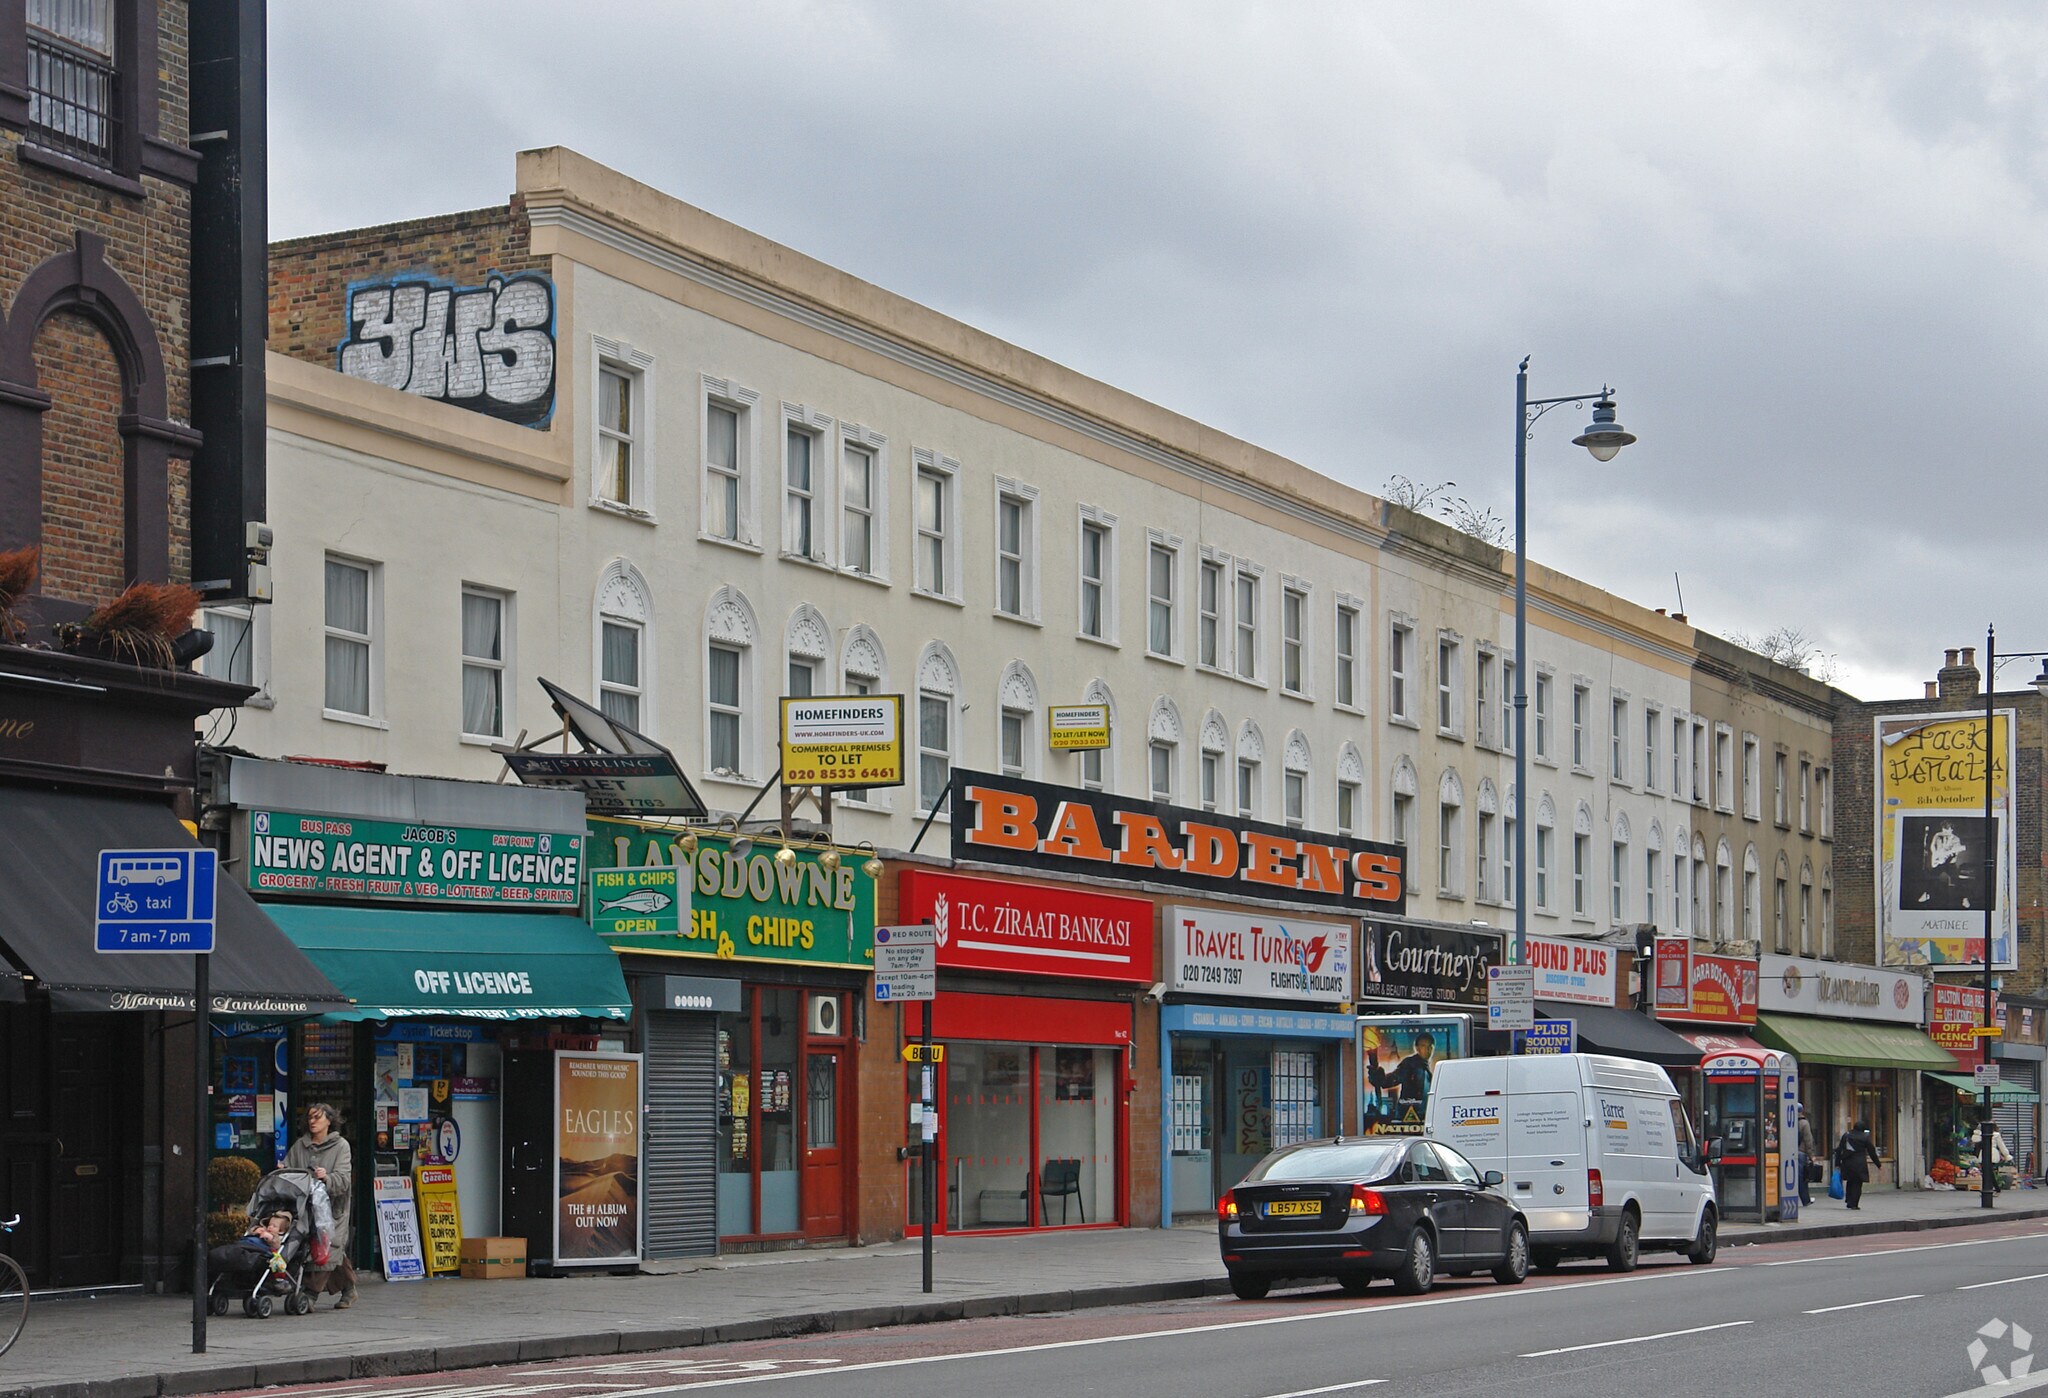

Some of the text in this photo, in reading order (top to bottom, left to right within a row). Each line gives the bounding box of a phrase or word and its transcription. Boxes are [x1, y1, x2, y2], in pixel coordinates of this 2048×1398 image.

[795, 708, 883, 720] HOMEFINDERS
[795, 730, 884, 738] WWW.HOMEFINDERS-UK.COM
[791, 744, 891, 753] COMMERCIAL PREMISES
[561, 759, 651, 768] STIRLING
[817, 754, 862, 765] TO LET
[789, 768, 894, 780] 020 8533 6461
[580, 779, 626, 791] LET
[1936, 795, 1975, 804] October
[300, 819, 352, 836] BUS PASS
[493, 834, 535, 848] PAY POINT
[965, 785, 1402, 902] BARDENS
[254, 835, 577, 885] NEWS AGENT & OFF LICENCE
[597, 871, 675, 887] FISH & CHIPS
[259, 873, 317, 889] GROCERY
[326, 877, 364, 893] FRESH
[368, 880, 401, 894] FRUIT
[404, 883, 412, 895] &
[415, 883, 437, 896] VEG
[446, 884, 495, 898] LOTTERY
[534, 890, 573, 901] SPIRITS
[146, 896, 172, 909] taxi
[614, 919, 657, 932] OPEN
[958, 901, 1131, 947] T.C. ZİRAAT BANKASI
[1921, 920, 1969, 930] MATINEE
[717, 915, 814, 959] & CHIPS
[1386, 930, 1488, 992] Courtney's
[1573, 947, 1607, 976] PLUS
[1183, 964, 1243, 985] 020 7249 7397
[1545, 973, 1586, 987] DISCOUNT STORE
[414, 969, 533, 995] OFF LICENCE
[1270, 972, 1343, 993] FLIGHTS & HOLIDAYS
[1366, 982, 1380, 994] HAIR
[1386, 984, 1409, 997] BEAUTY
[1411, 987, 1433, 999] BARBER
[1436, 988, 1456, 1001] STUDIO
[1937, 990, 1961, 1005] DALSTON
[110, 993, 307, 1014] Marquis Lansdowne
[518, 1008, 542, 1017] PAY
[544, 1008, 582, 1016] POINT
[429, 1026, 473, 1039] Ticket Stop
[1534, 1024, 1568, 1035] PLUS
[1942, 1024, 1961, 1032] OFF
[1526, 1037, 1570, 1047] SCOUNT
[1931, 1033, 1973, 1041] LICENCE
[569, 1062, 629, 1072] REMEMBER WHEN MUSIC
[571, 1070, 627, 1079] SOUNDED THIS GOOD
[1451, 1105, 1499, 1119] Farrer
[1600, 1099, 1625, 1119] Farrer
[565, 1108, 634, 1135] EAGLES
[422, 1171, 452, 1184] Gazette
[568, 1204, 627, 1215] THE #1 ALBUM
[1271, 1202, 1320, 1214] LB57 XSZ
[429, 1214, 455, 1225] BIG APPLE
[575, 1216, 619, 1228] OUT NOW
[389, 1222, 407, 1233] TUBE
[389, 1233, 412, 1244] STRIKE
[430, 1229, 457, 1239] BLOW FOR
[435, 1242, 454, 1253] METRIC
